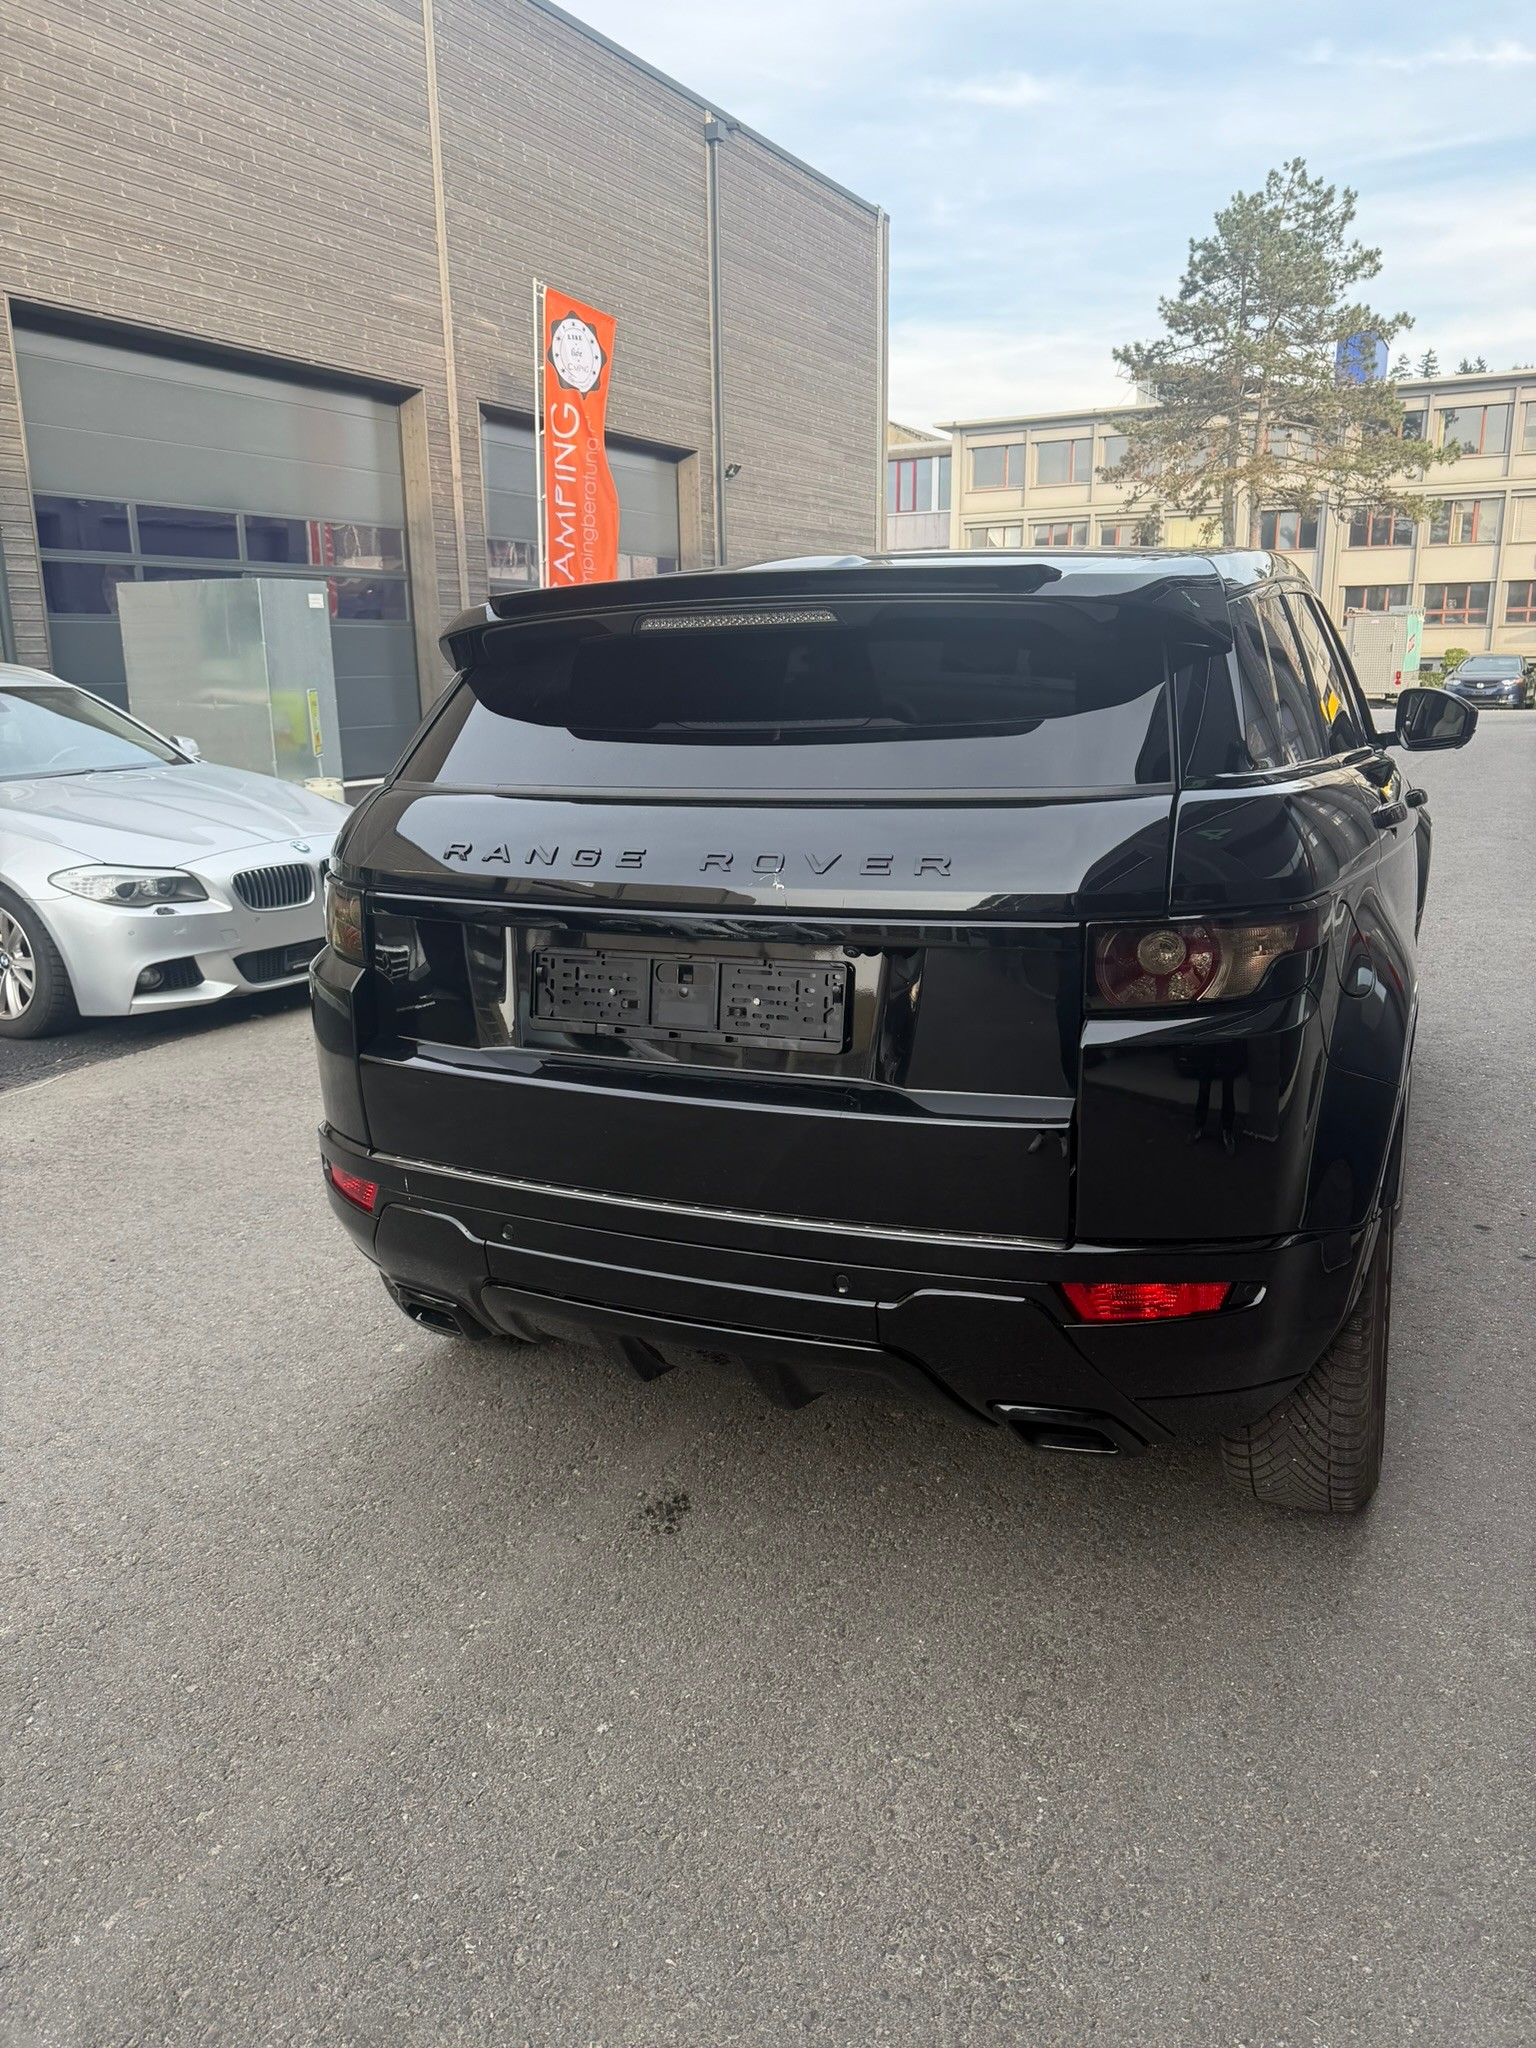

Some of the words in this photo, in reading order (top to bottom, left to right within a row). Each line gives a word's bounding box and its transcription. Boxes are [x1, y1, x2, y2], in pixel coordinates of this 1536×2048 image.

[550, 403, 580, 588] AMPING
[443, 842, 647, 869] RANGE
[700, 851, 952, 876] ROVER
